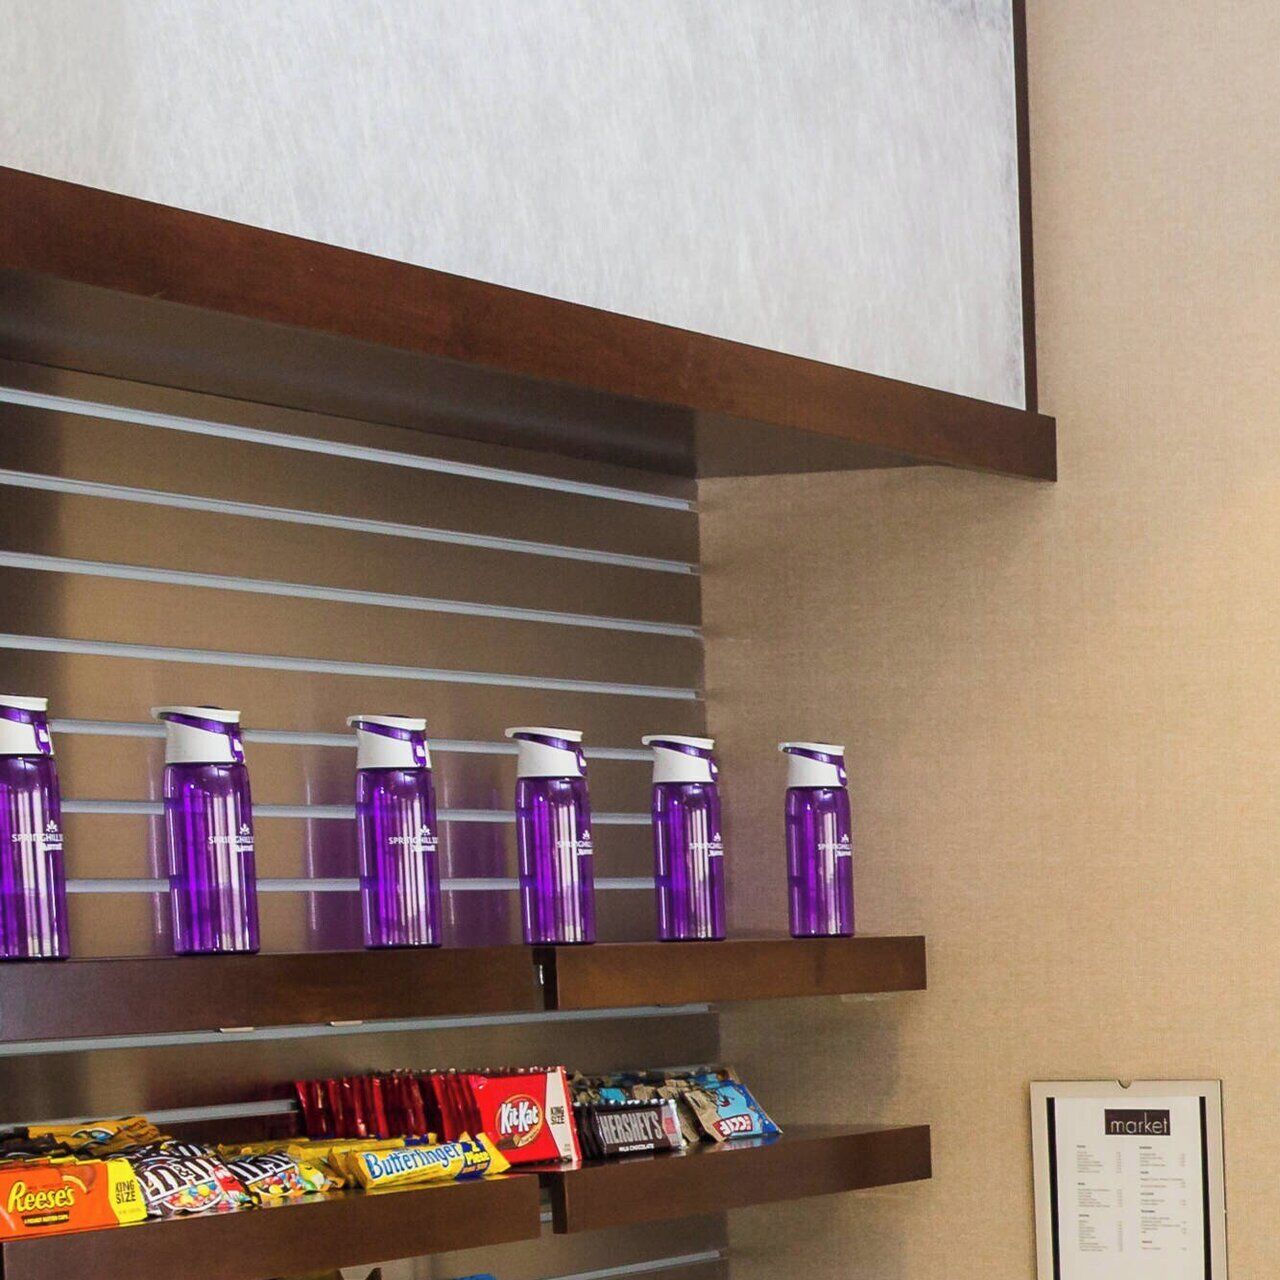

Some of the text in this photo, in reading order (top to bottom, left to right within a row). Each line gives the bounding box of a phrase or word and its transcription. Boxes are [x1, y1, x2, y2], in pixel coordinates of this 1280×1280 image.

[600, 1110, 664, 1144] HERSHEY'S
[1110, 1112, 1168, 1135] market
[363, 1142, 461, 1179] Butterfinger
[7, 1180, 75, 1213] Reese's
[115, 1180, 135, 1193] KING
[116, 1191, 137, 1205] SIZE
